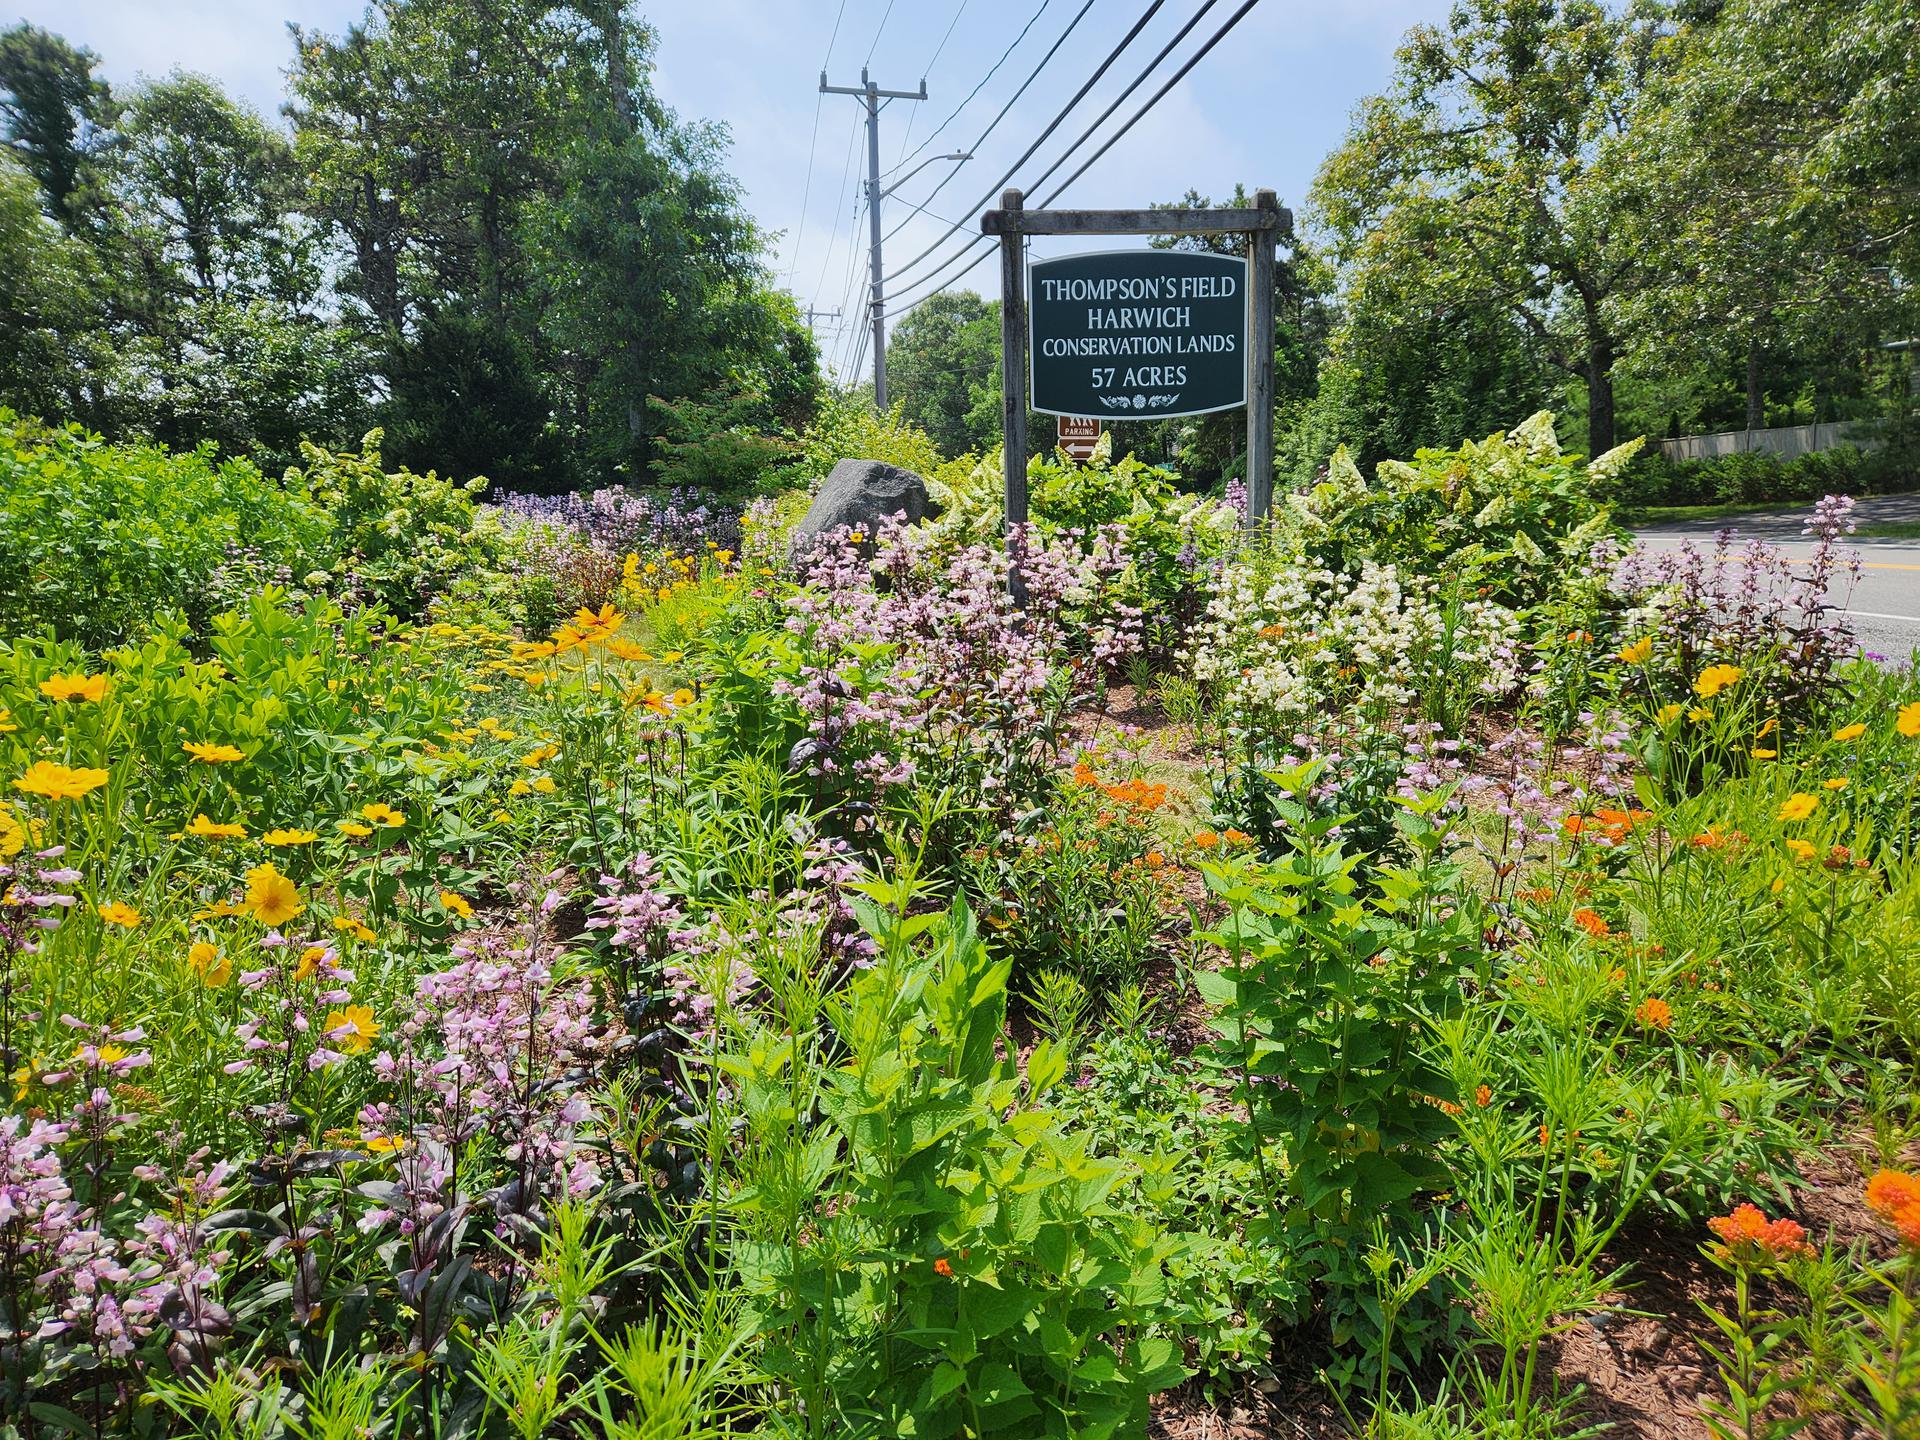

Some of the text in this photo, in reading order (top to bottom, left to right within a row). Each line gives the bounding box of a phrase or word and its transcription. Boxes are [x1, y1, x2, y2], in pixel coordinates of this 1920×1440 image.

[1042, 276, 1235, 300] THOMPSON'S FIELD
[1088, 307, 1190, 329] HARWICH
[1043, 335, 1235, 356] CONSERVATION LANDS
[1092, 366, 1186, 387] 57 ACRES
